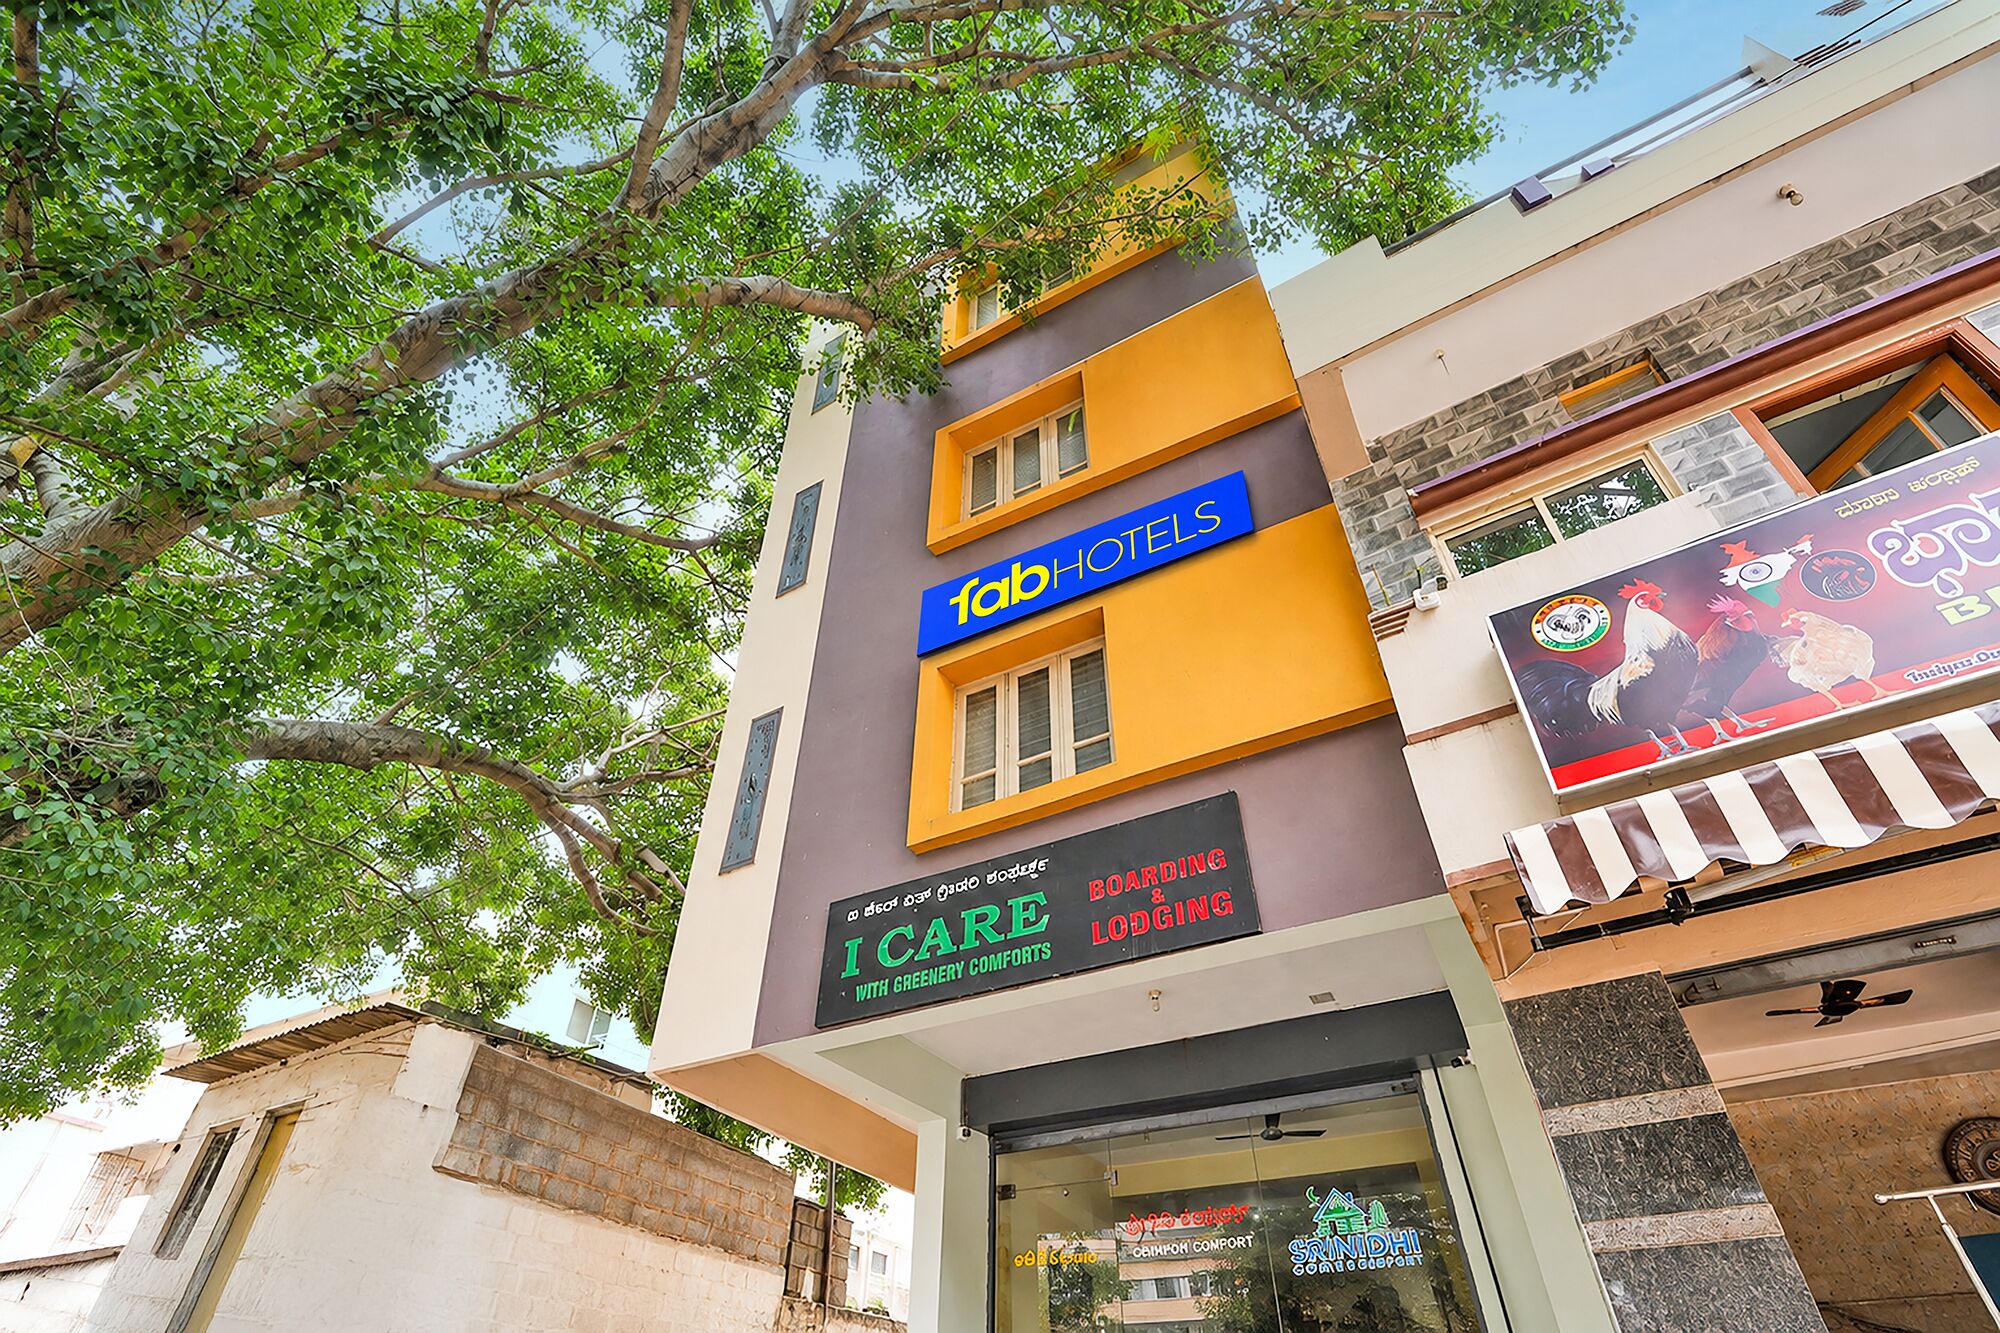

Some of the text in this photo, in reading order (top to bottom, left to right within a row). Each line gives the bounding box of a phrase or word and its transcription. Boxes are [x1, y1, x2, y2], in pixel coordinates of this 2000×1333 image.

[1088, 848, 1228, 901] BOARDING
[1150, 887, 1166, 904] &
[841, 891, 1051, 979] I CARE
[1092, 890, 1234, 946] LODGING
[855, 942, 1052, 1003] WITH GREENERY COMFORTS
[1288, 1229, 1423, 1264] SRINIDHI
